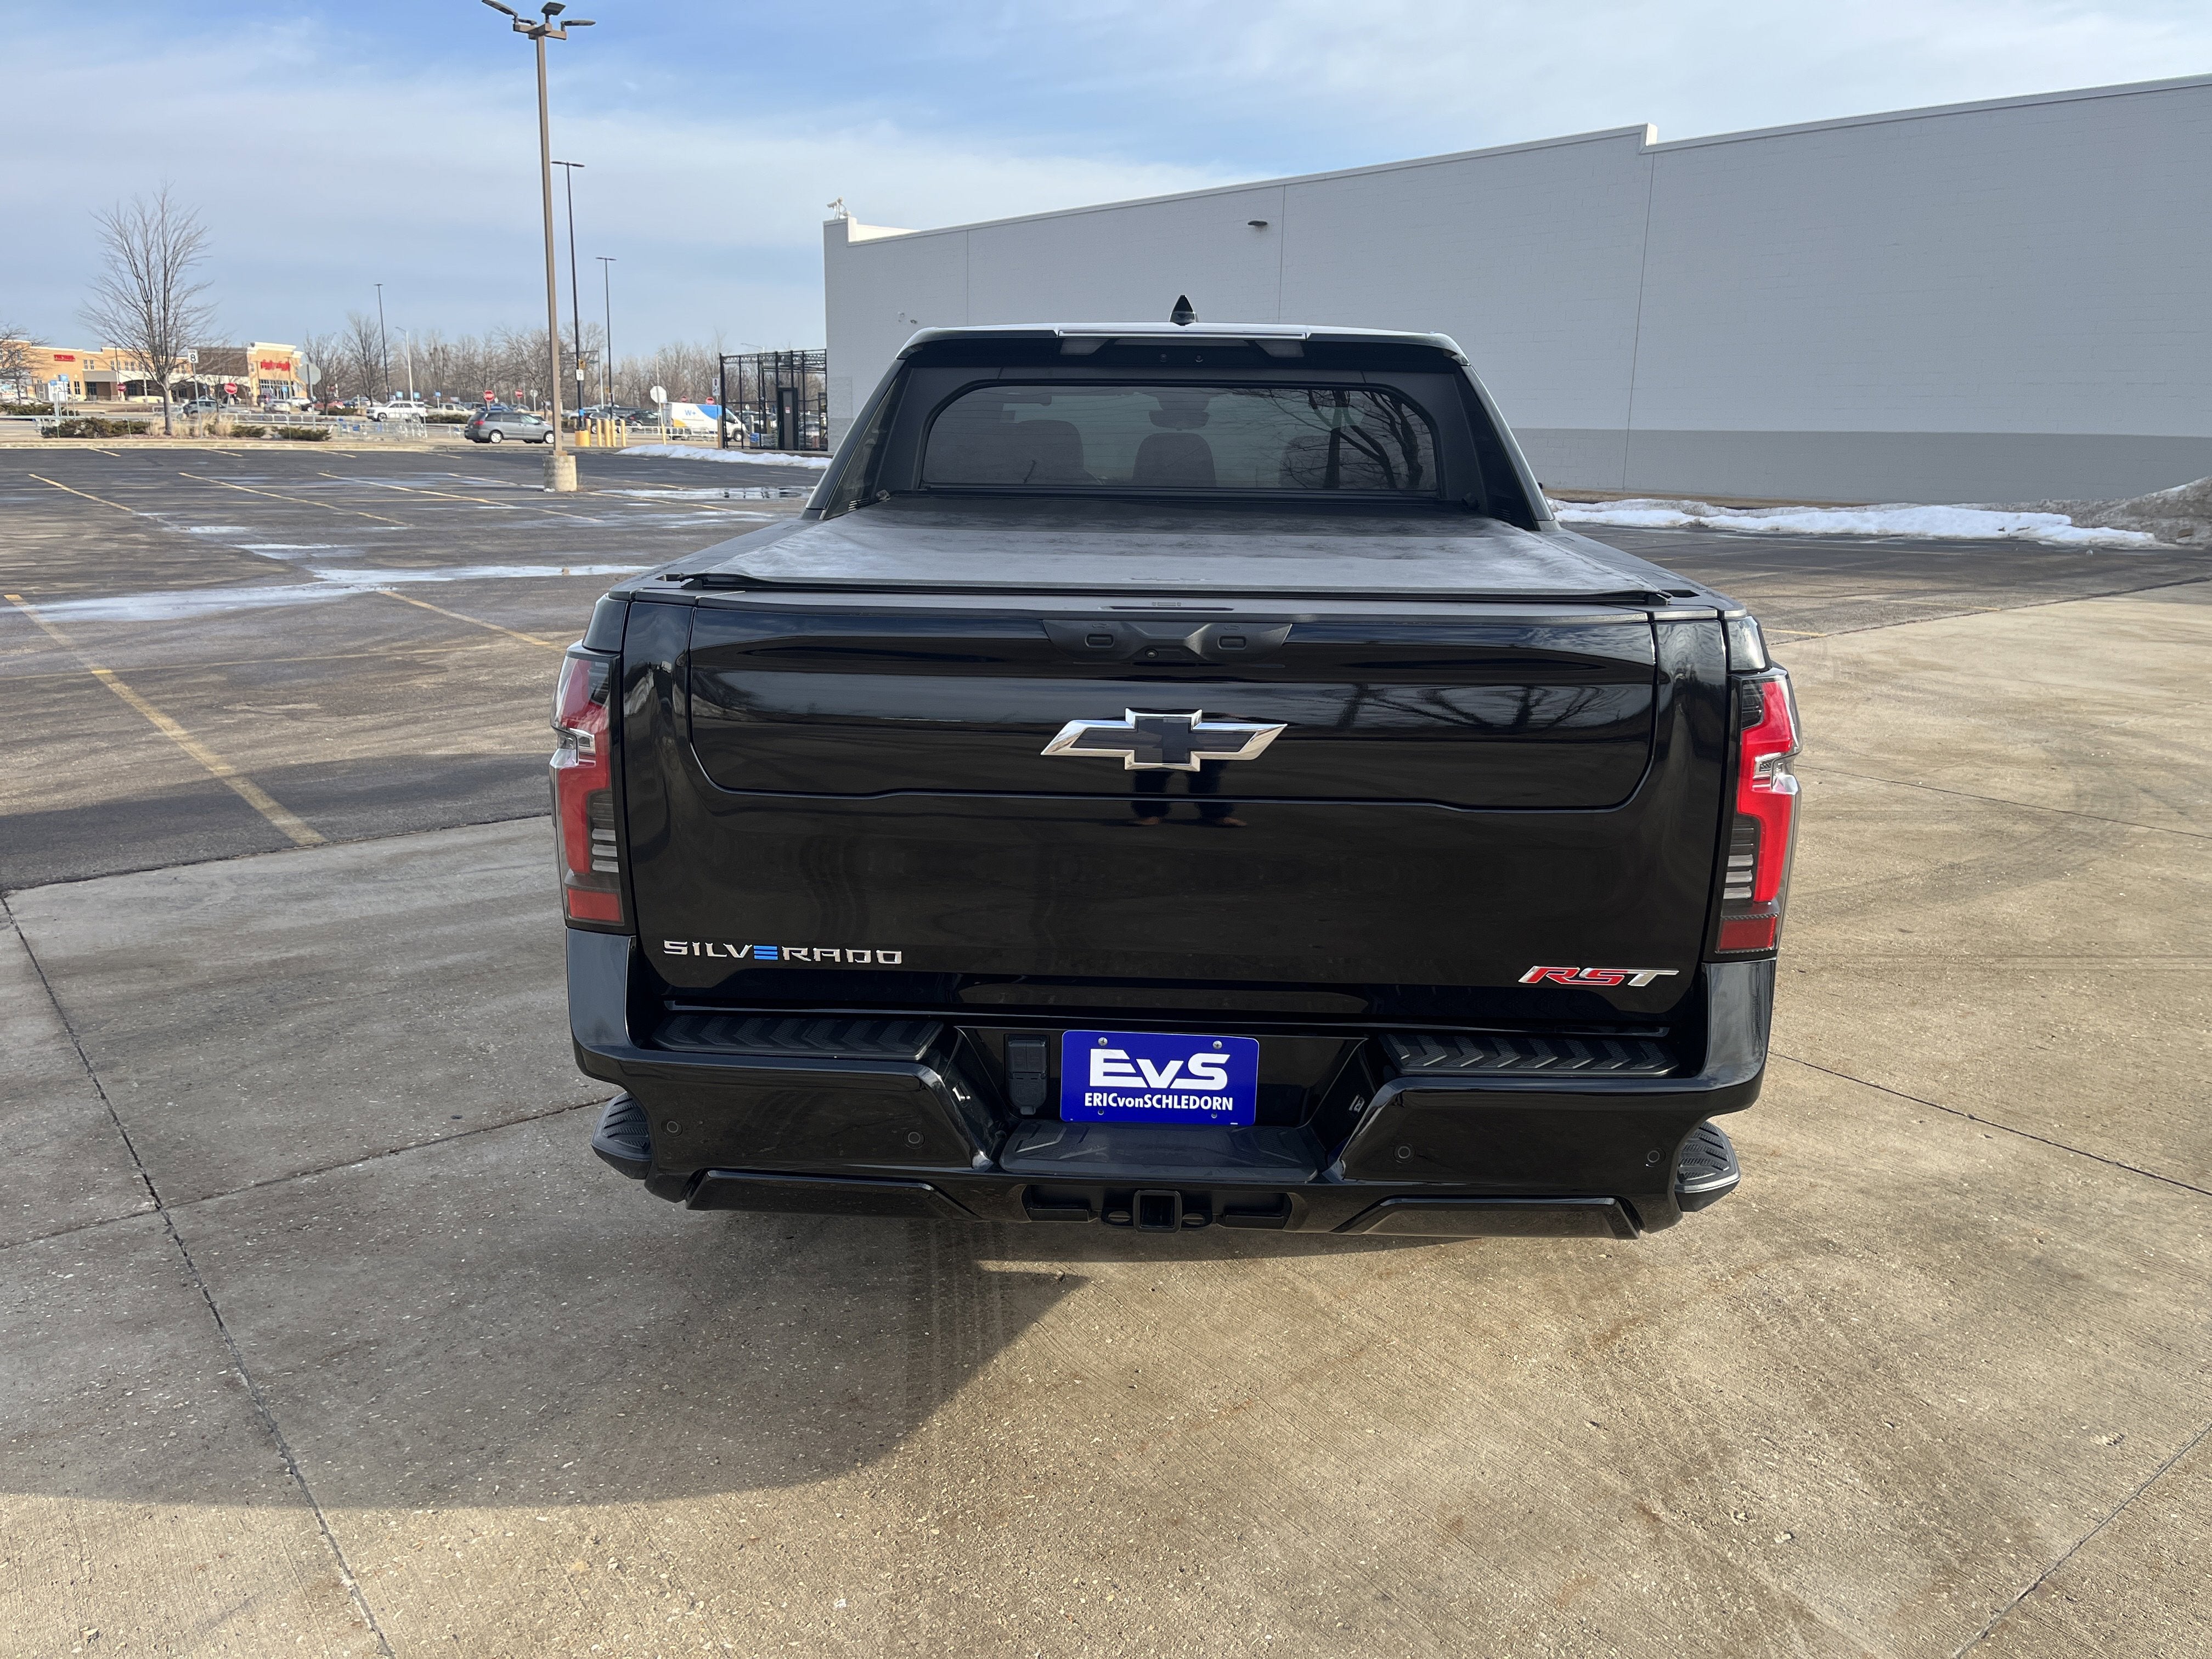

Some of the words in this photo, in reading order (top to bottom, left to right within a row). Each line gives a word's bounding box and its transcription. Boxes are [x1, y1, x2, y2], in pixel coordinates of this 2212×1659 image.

[190, 354, 196, 362] 8
[663, 940, 902, 964] SILVERADO
[1517, 965, 1680, 987] RST
[1084, 1092, 1233, 1111] ERICvonSCHLEDORN
